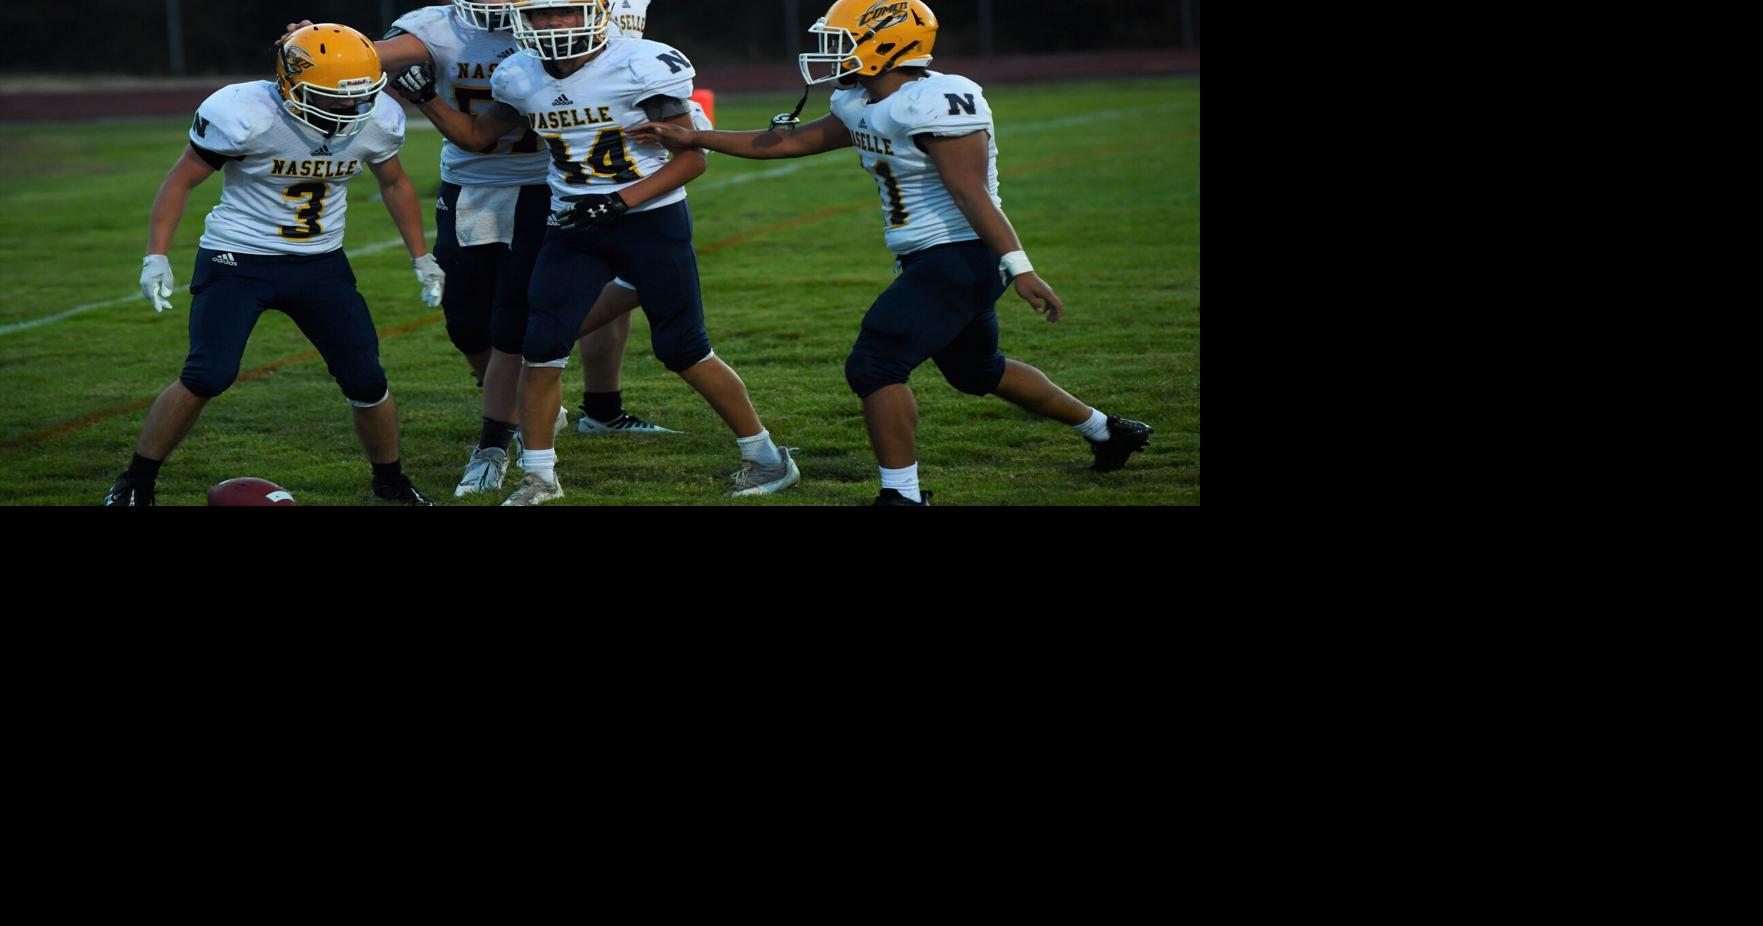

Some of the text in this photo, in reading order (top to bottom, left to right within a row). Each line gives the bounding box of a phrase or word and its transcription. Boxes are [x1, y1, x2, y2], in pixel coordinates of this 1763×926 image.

[655, 50, 691, 74] N
[943, 93, 976, 116] N
[193, 111, 210, 138] N
[271, 159, 358, 177] NASELLE
[544, 127, 642, 185] 14
[277, 181, 329, 242] 3
[211, 256, 238, 266] adidas
